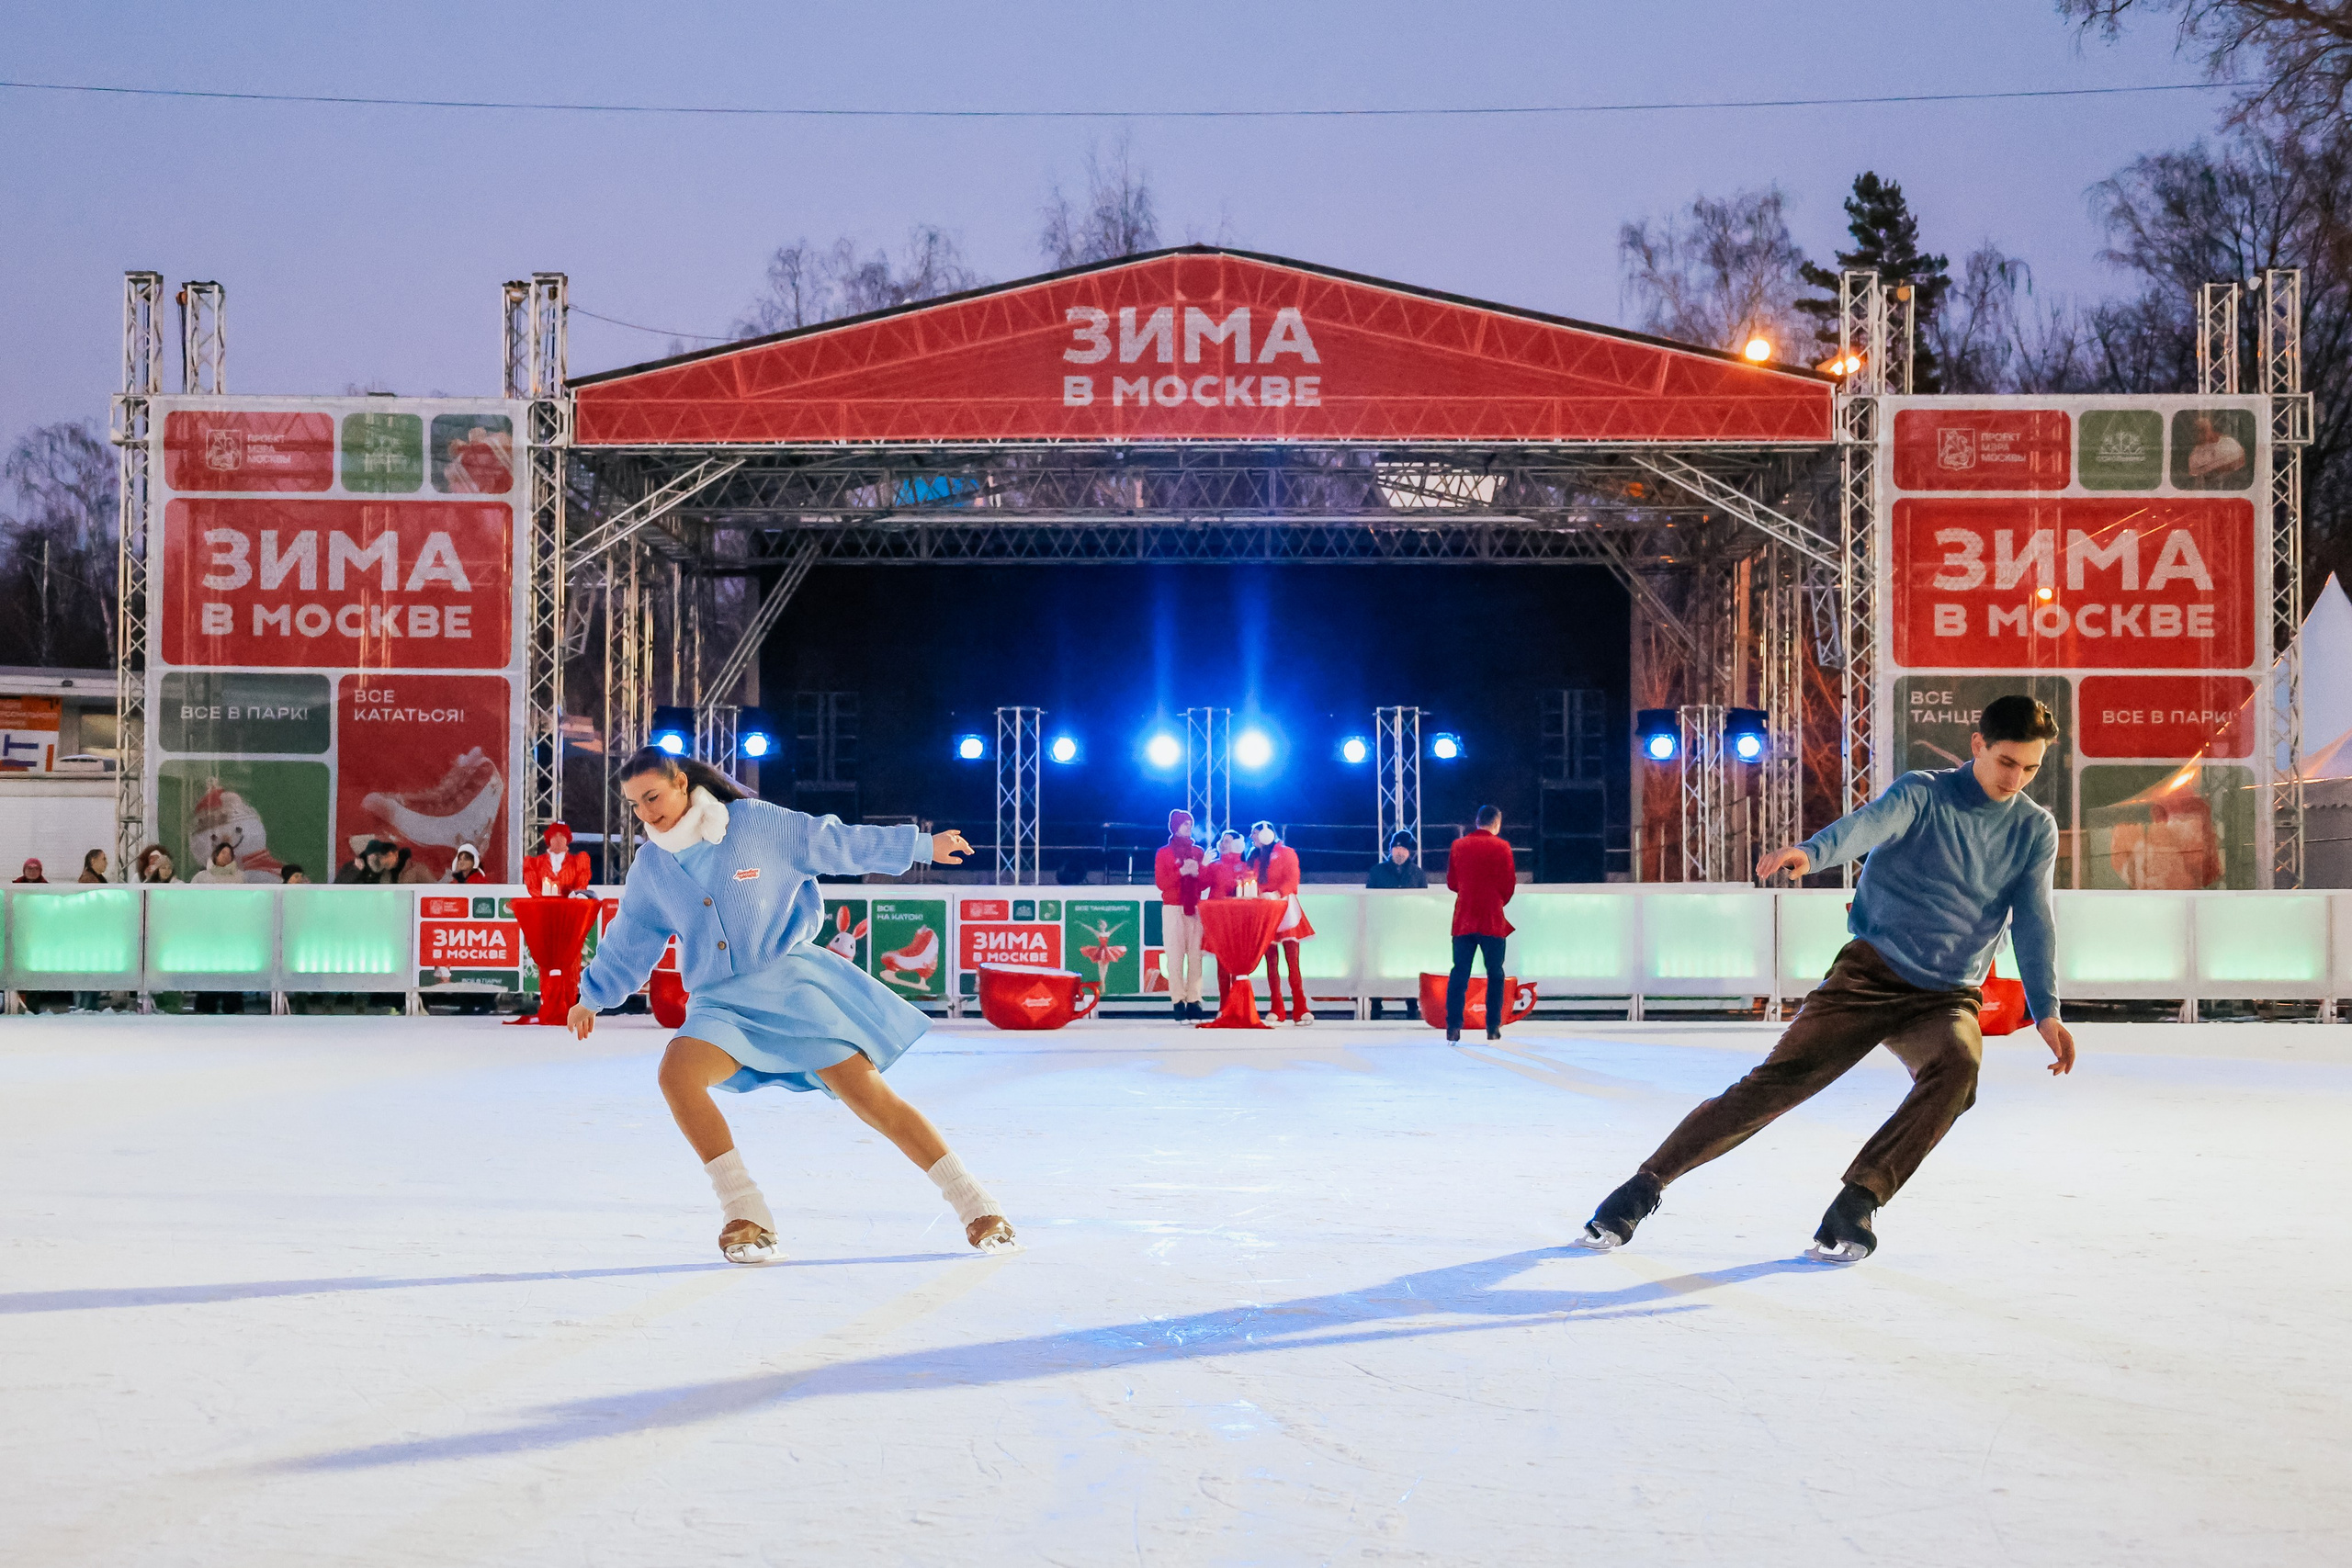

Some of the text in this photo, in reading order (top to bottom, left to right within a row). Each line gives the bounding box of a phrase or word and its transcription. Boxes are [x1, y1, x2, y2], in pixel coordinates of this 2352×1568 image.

[1063, 306, 1321, 364] ЗИМА
[1063, 375, 1321, 407] В МОСКВЕ
[202, 528, 472, 592] ЗИМА
[1933, 528, 2214, 591] ЗИМА
[201, 603, 472, 637] В МОСКВЕ
[1934, 604, 2215, 638] В МОСКВЕ
[355, 690, 395, 704] ВСЕ
[1910, 691, 1953, 705] ВСЕ
[180, 706, 308, 720] ВСЕ В ПАРК!
[354, 708, 465, 723] КАТАТЬСЯ!
[1911, 709, 1982, 726] ТАНЦЕ
[2102, 710, 2233, 724] ВСЕ В ПАРК!
[433, 929, 506, 947] ЗИМА
[973, 931, 1047, 950] ЗИМА
[433, 949, 506, 959] В МОСКВЕ
[973, 952, 1047, 963] В МОСКВЕ
